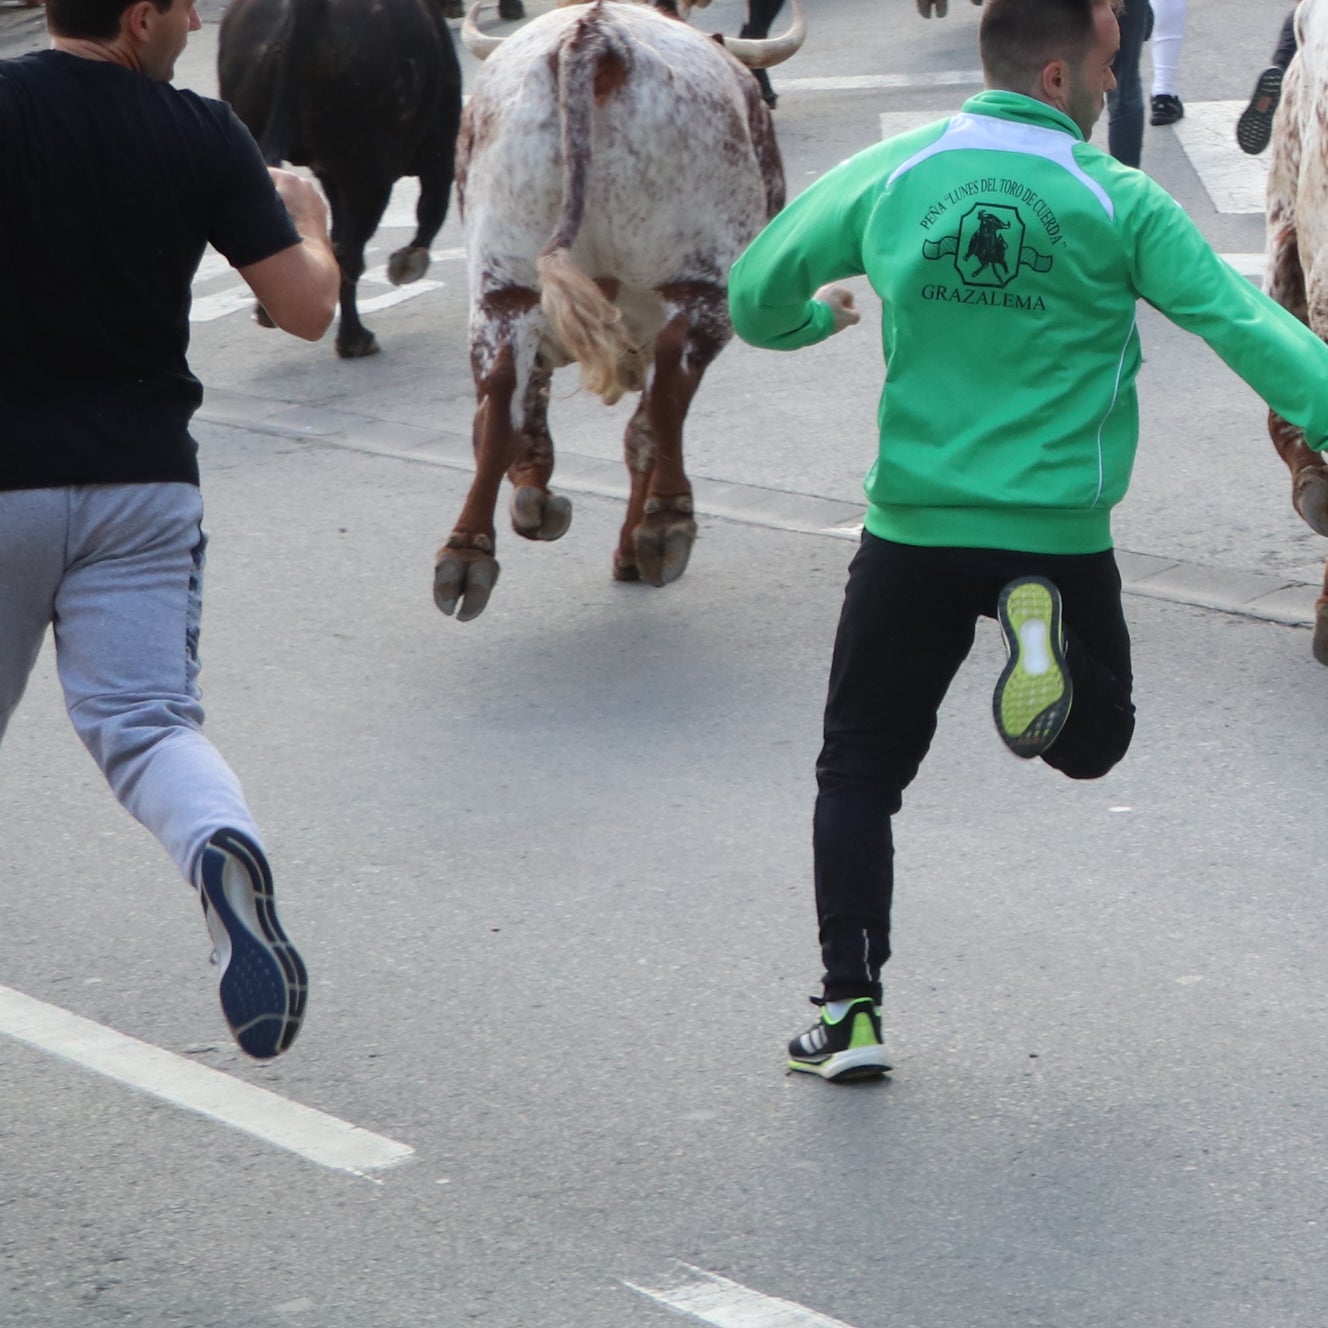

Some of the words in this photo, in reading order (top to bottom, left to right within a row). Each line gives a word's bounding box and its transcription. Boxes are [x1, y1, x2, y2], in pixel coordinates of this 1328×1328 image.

[920, 202, 947, 230] PEÑA
[981, 177, 998, 193] DEL
[1000, 178, 1024, 199] TORO
[1021, 188, 1039, 207] DE
[921, 284, 1046, 310] GRAZALEMA
